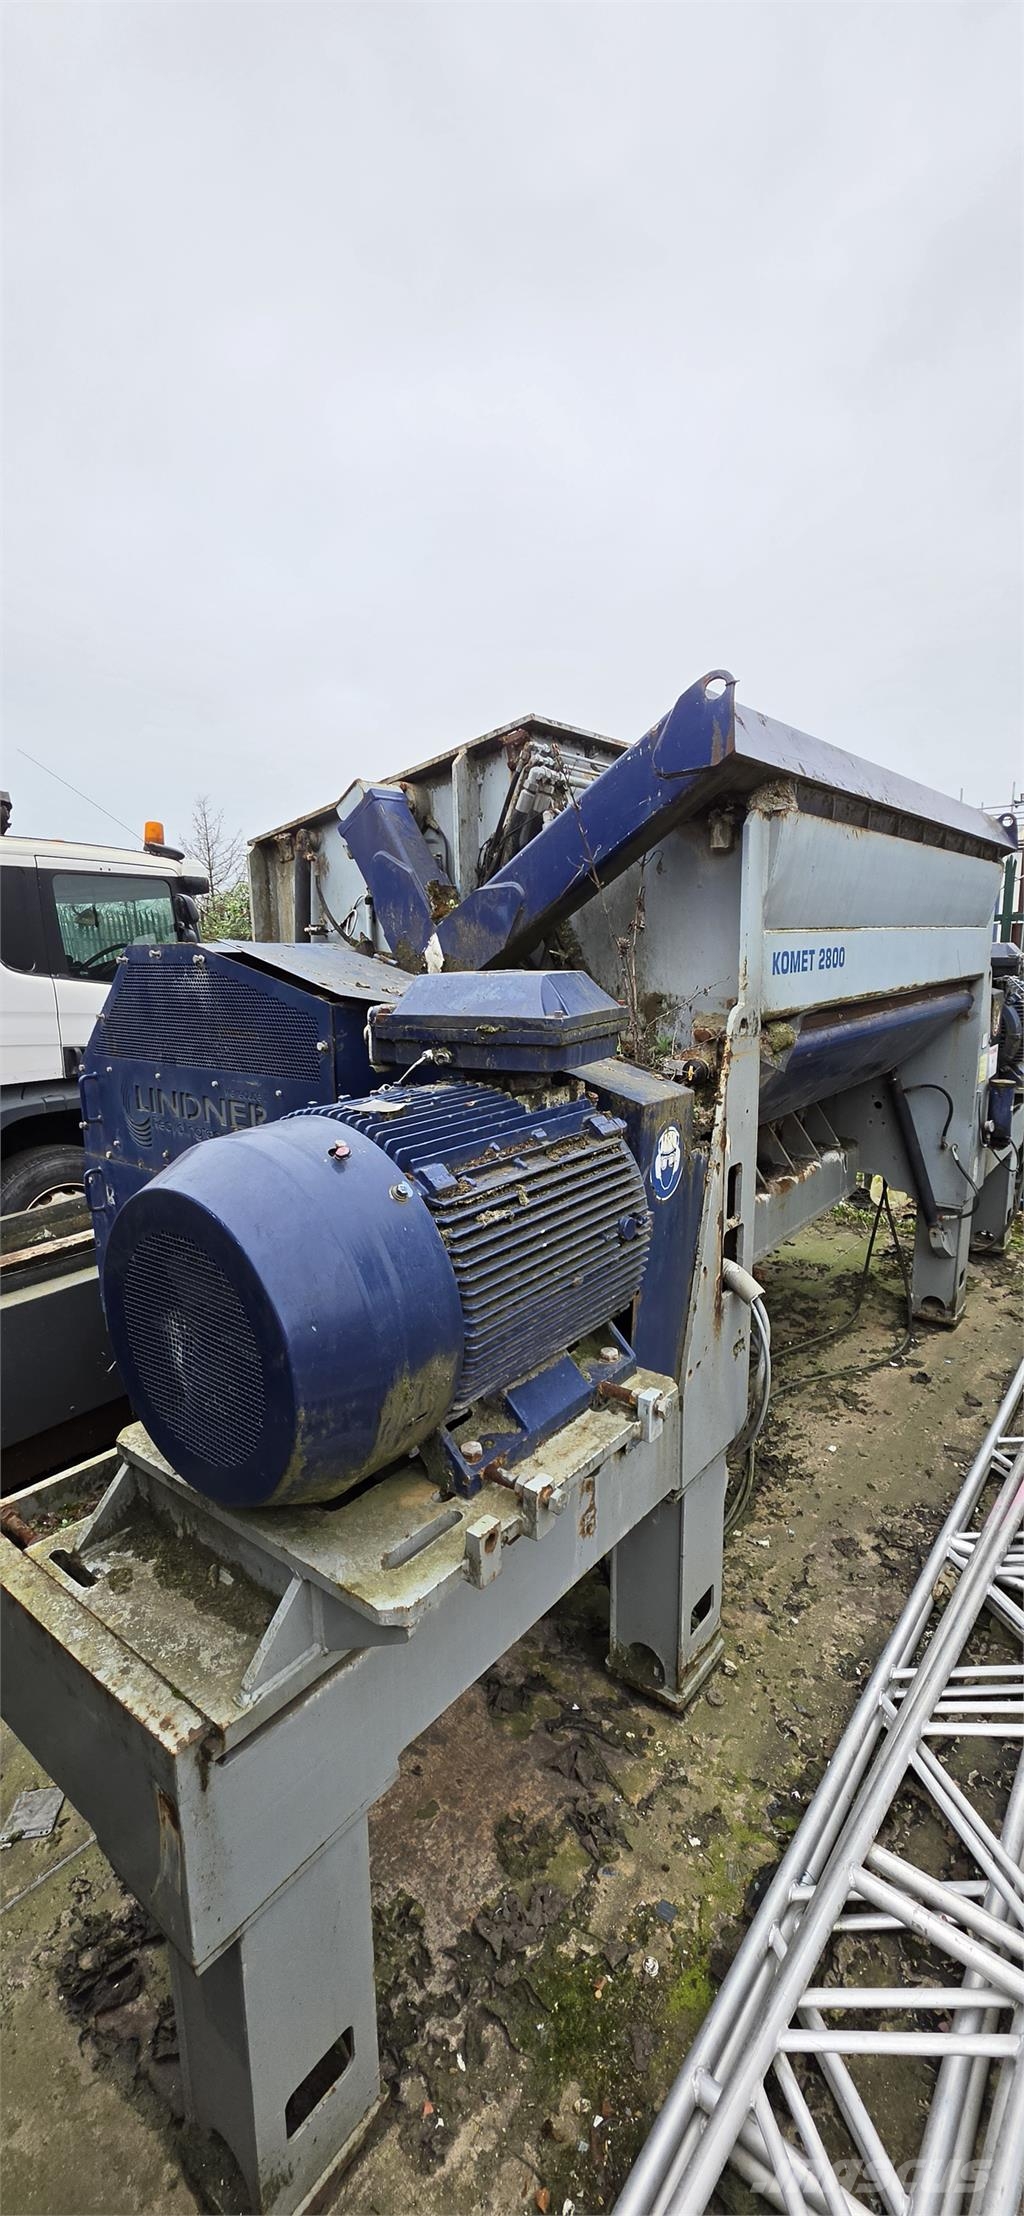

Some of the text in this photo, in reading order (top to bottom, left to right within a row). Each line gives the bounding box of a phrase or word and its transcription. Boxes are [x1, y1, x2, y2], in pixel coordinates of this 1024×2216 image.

[772, 946, 845, 976] KOMET 2800
[134, 1084, 267, 1130] LINDNER
